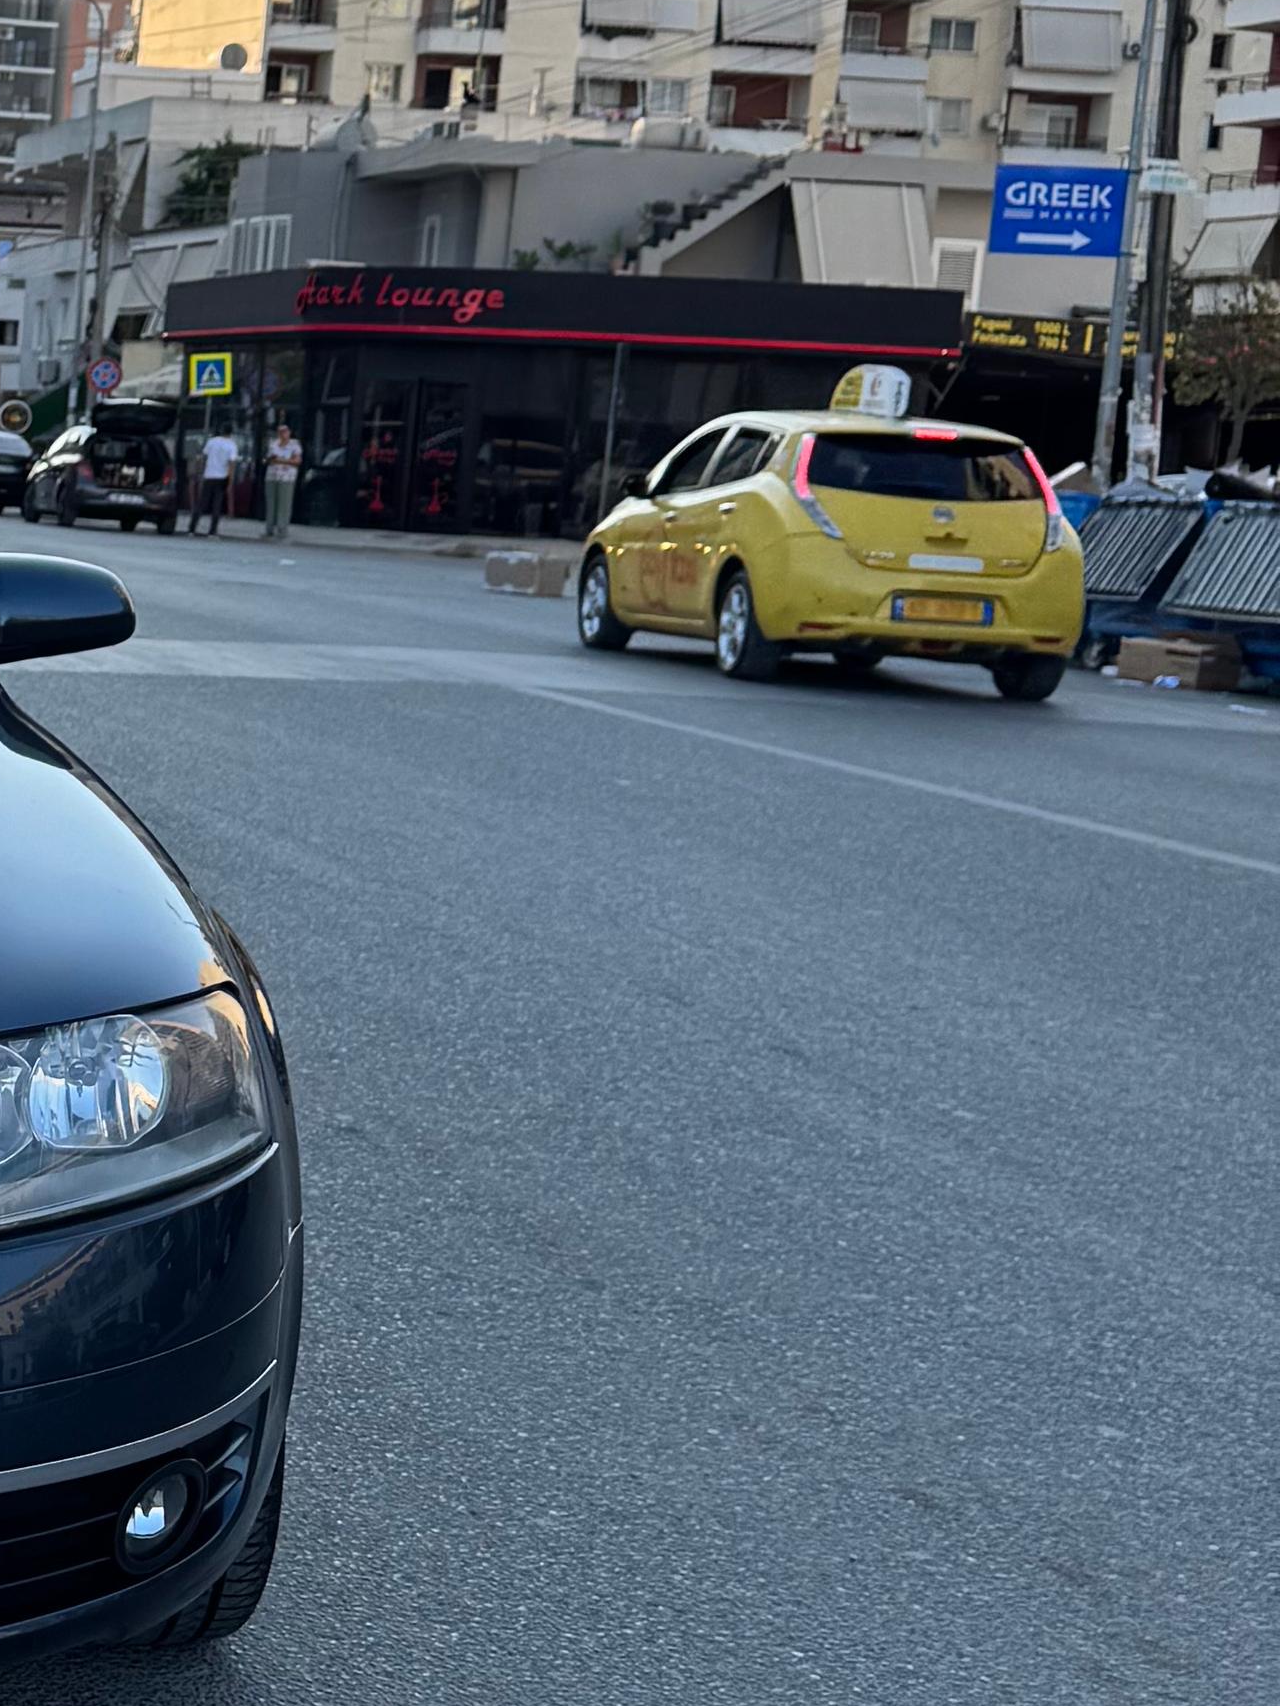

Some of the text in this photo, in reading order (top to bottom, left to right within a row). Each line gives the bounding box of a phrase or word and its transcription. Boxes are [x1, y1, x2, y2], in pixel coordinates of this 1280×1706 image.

[1005, 180, 1113, 209] GREEK
[1039, 210, 1111, 223] MARKET
[375, 273, 505, 323] lounge
